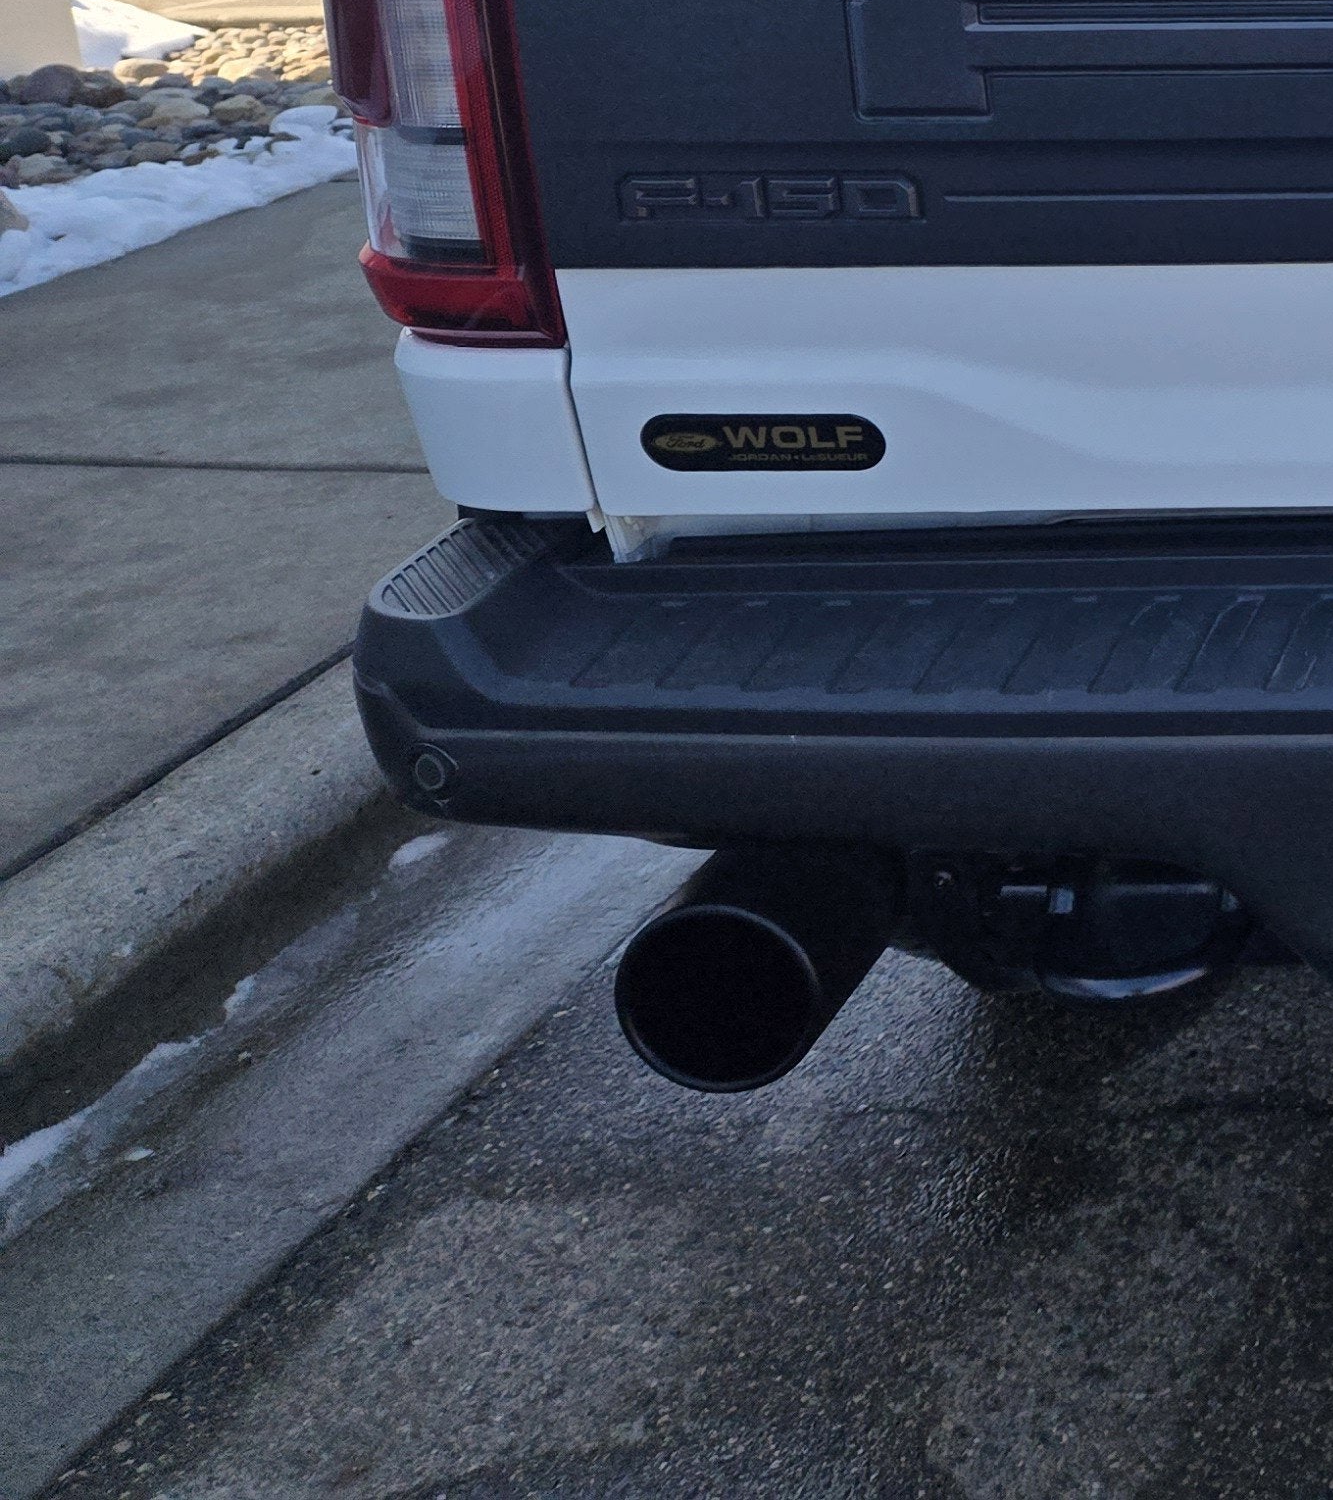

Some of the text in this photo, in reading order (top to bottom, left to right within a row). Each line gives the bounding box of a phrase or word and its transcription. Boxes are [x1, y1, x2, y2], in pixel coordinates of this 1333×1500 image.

[616, 172, 922, 220] F-150
[666, 434, 706, 449] Ford
[721, 425, 864, 449] WOLF
[729, 452, 792, 462] JORDAN
